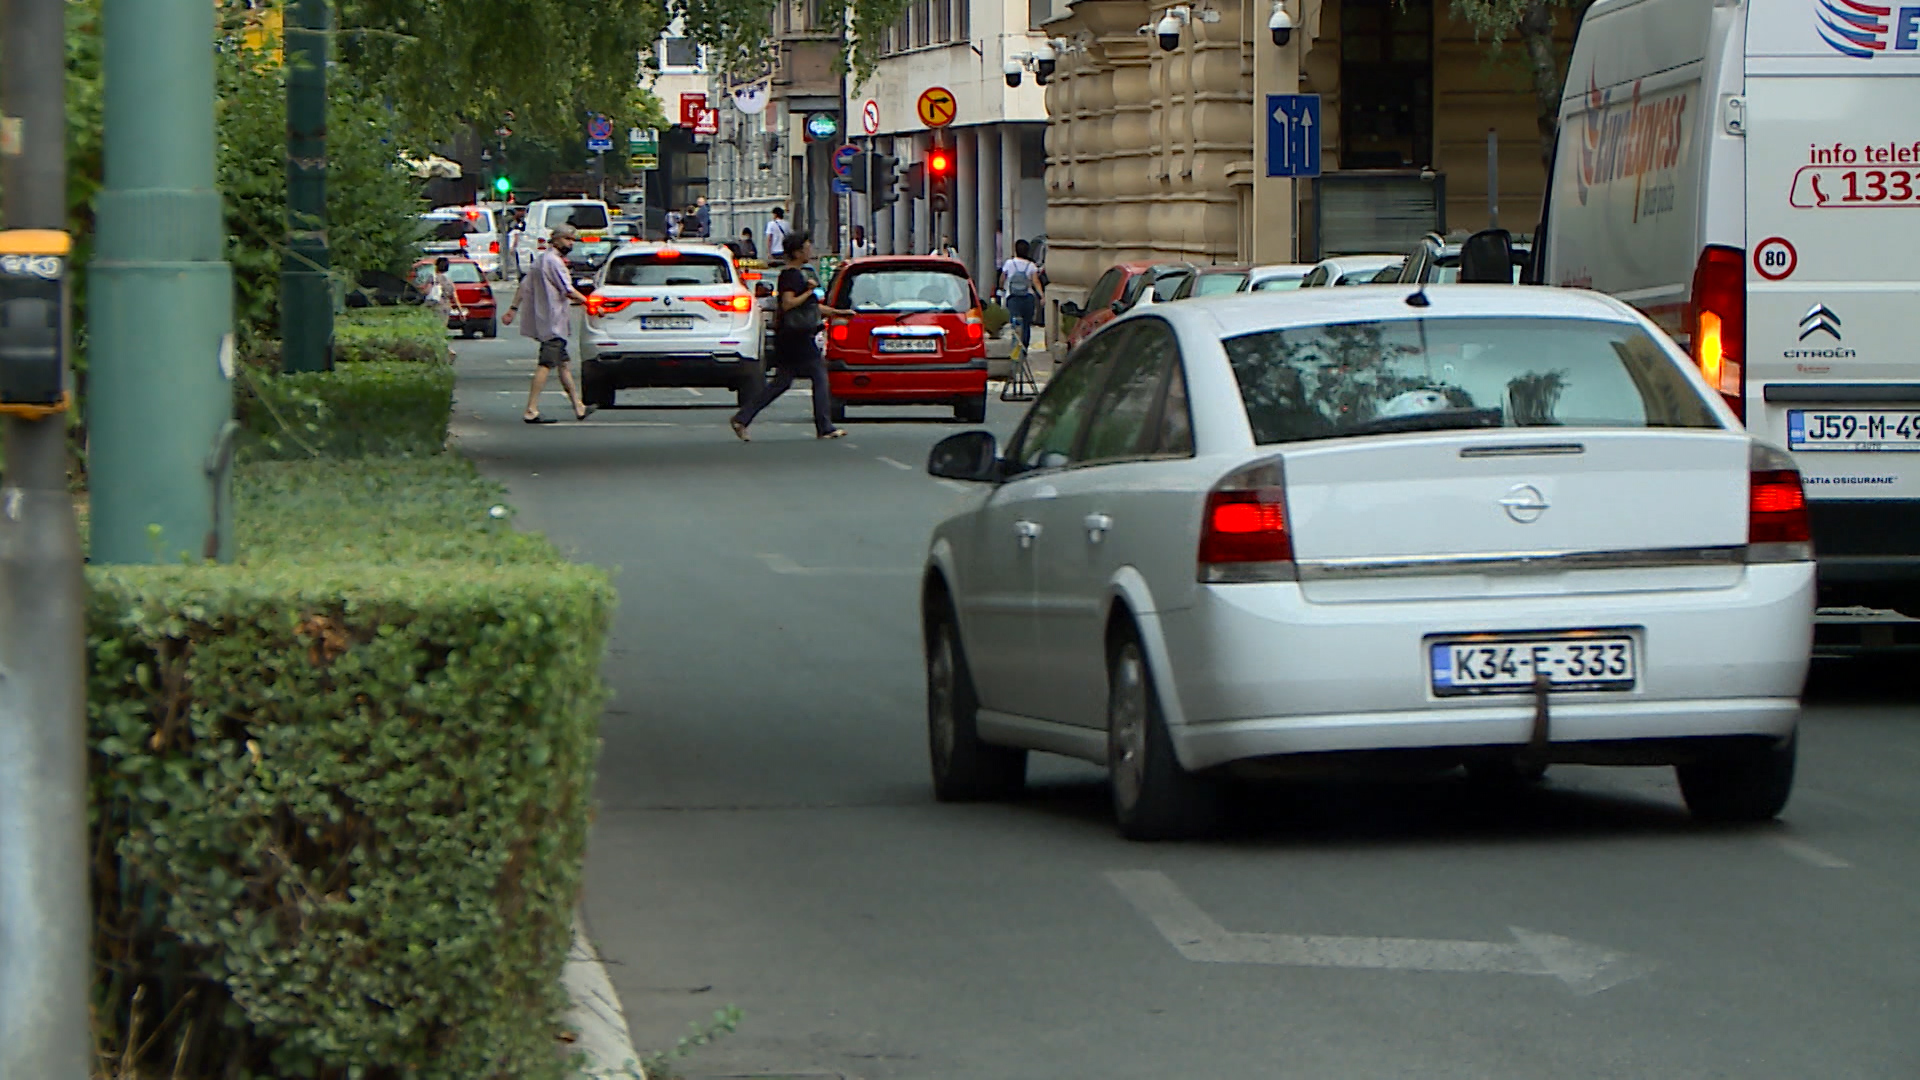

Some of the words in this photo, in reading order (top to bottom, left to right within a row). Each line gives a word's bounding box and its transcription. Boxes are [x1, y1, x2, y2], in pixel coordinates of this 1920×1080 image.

[1810, 143, 1857, 163] info
[1842, 170, 1920, 201] 133
[1765, 250, 1786, 266] 80
